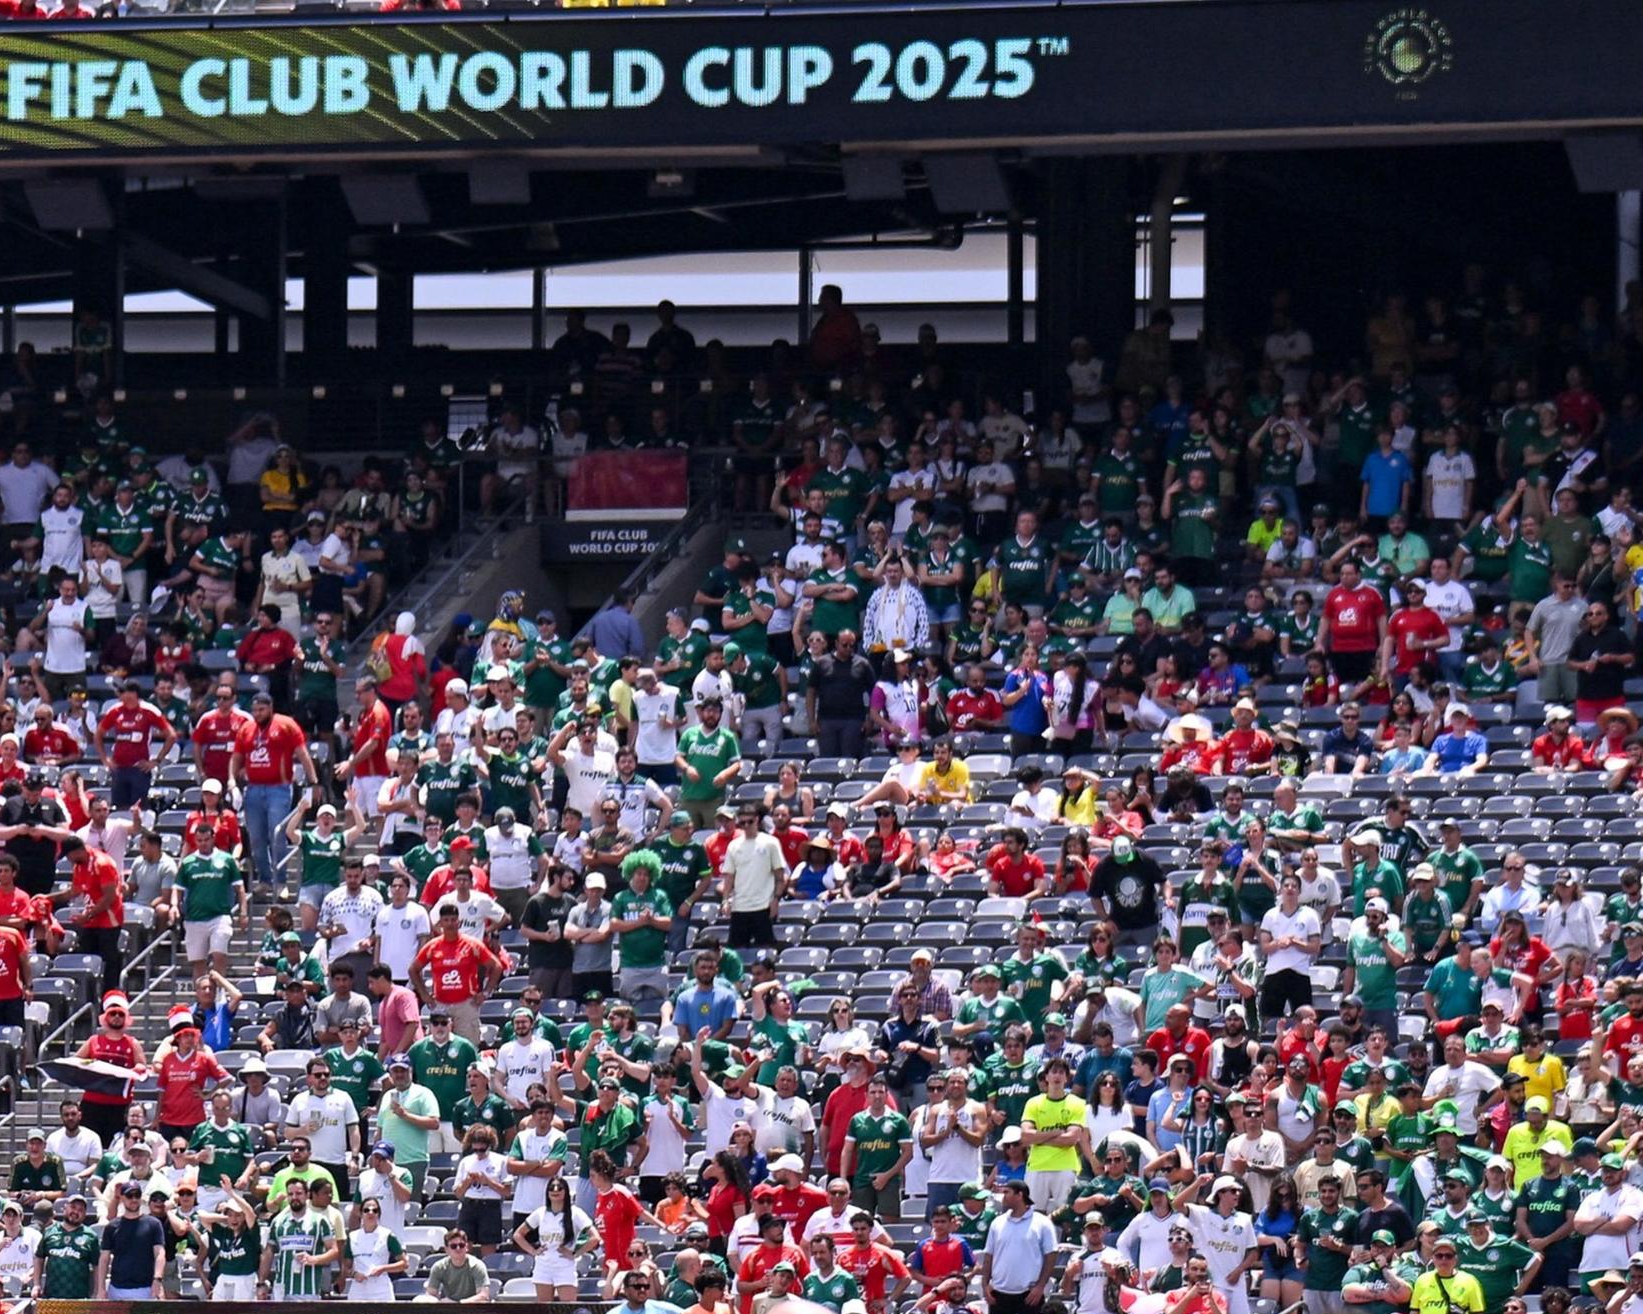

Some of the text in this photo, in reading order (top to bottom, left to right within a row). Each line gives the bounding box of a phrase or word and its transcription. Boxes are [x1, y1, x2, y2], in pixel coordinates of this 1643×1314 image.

[7, 60, 164, 122] FIFA
[179, 56, 372, 119] CLUB
[391, 49, 666, 116] WORLD
[684, 45, 834, 109] CUP
[590, 530, 648, 541] FIFA CLUB
[569, 542, 659, 554] WORLD CUP 20
[905, 700, 916, 712] 10
[430, 780, 460, 789] crefisa
[1356, 955, 1386, 965] crefisa
[426, 1066, 457, 1075] crefisa
[998, 1085, 1029, 1095] crefisa
[860, 1140, 891, 1149] crefisa
[1529, 1202, 1561, 1212] crefisa
[49, 1248, 80, 1259] crefisa
